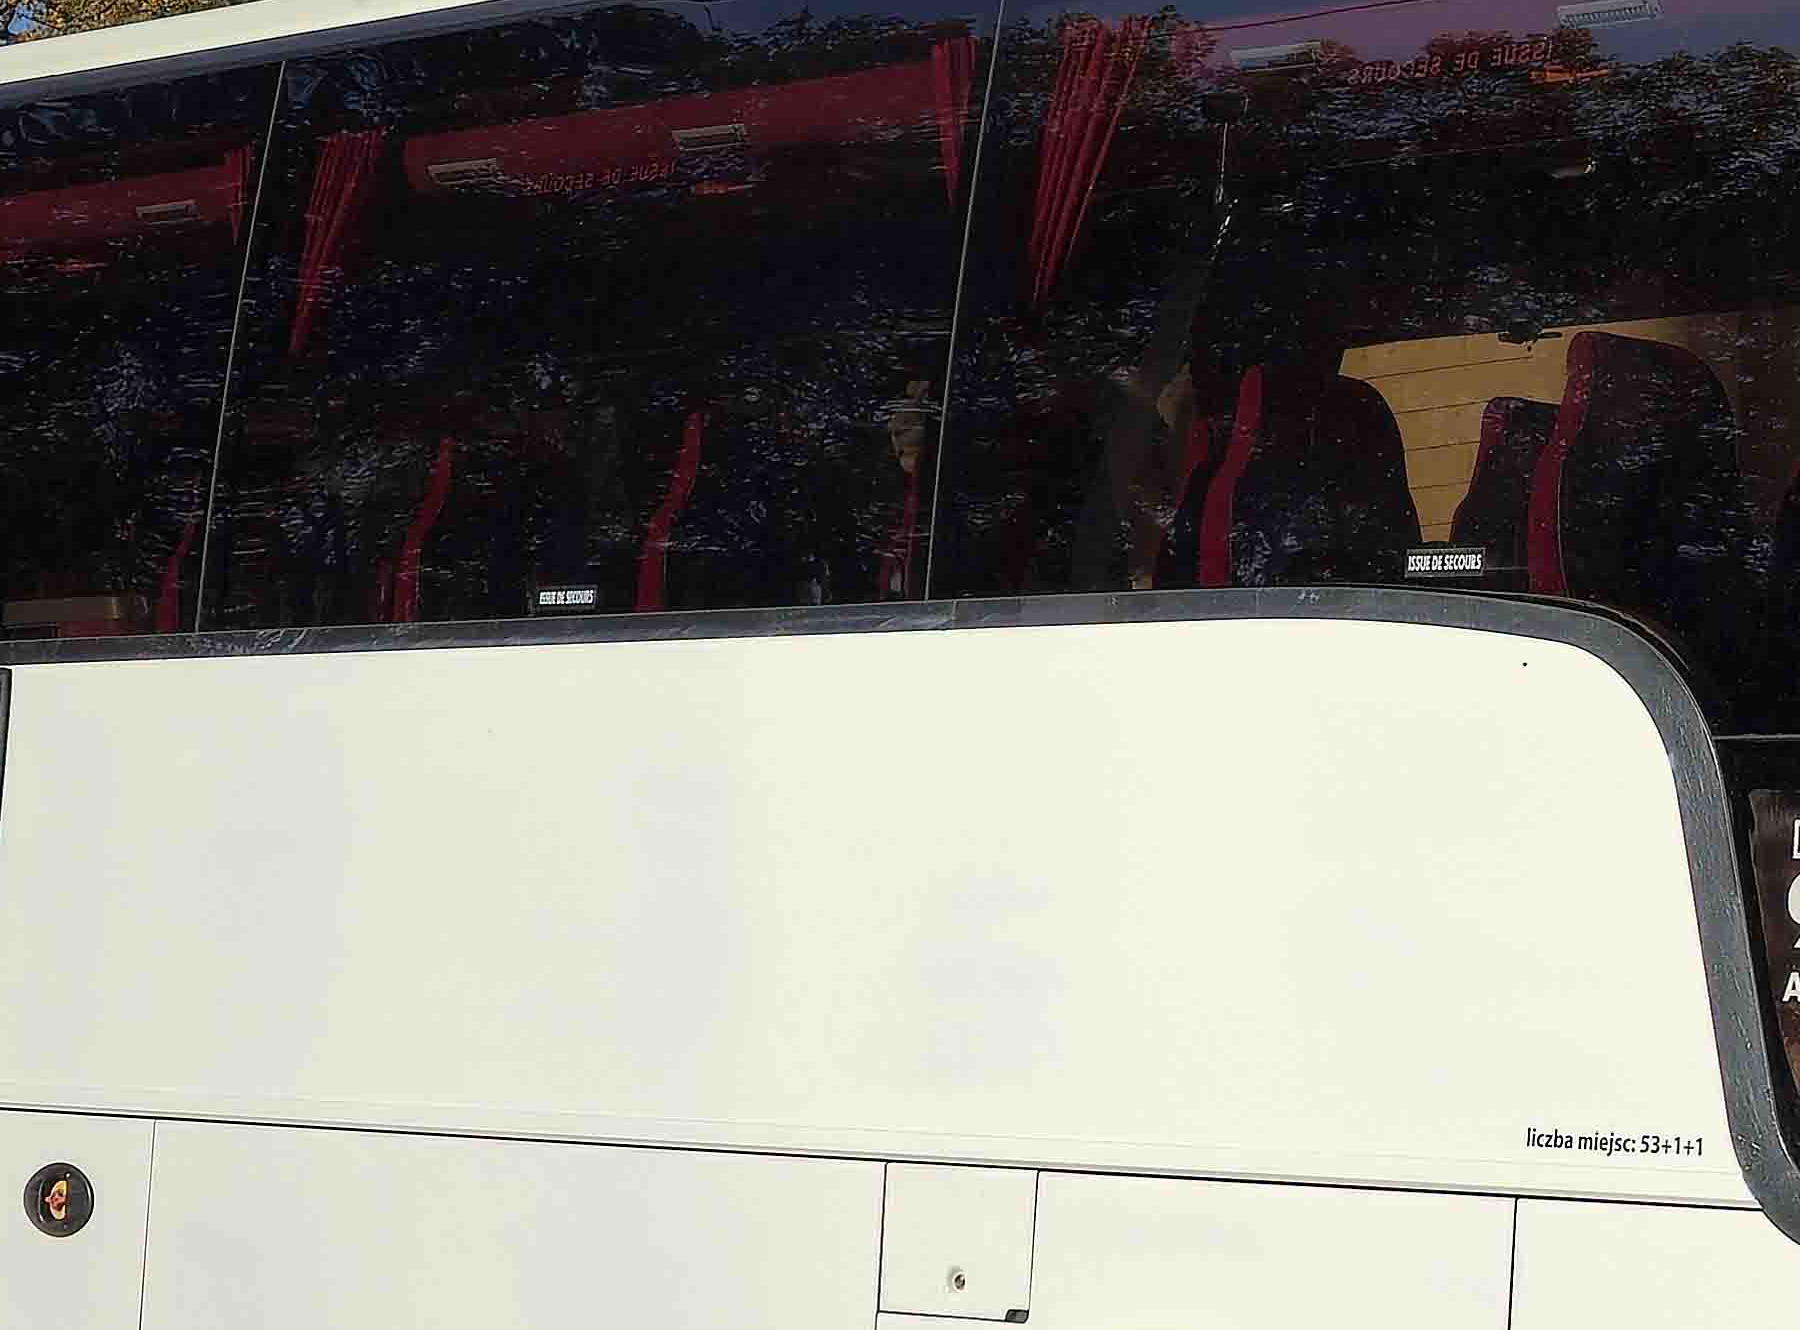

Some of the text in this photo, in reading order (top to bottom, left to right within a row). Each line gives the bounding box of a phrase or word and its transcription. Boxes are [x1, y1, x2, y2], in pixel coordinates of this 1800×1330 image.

[1408, 553, 1482, 571] ISSUE DE SECOURS
[1526, 1127, 1703, 1157] liczba miejsc: 53+1+1
